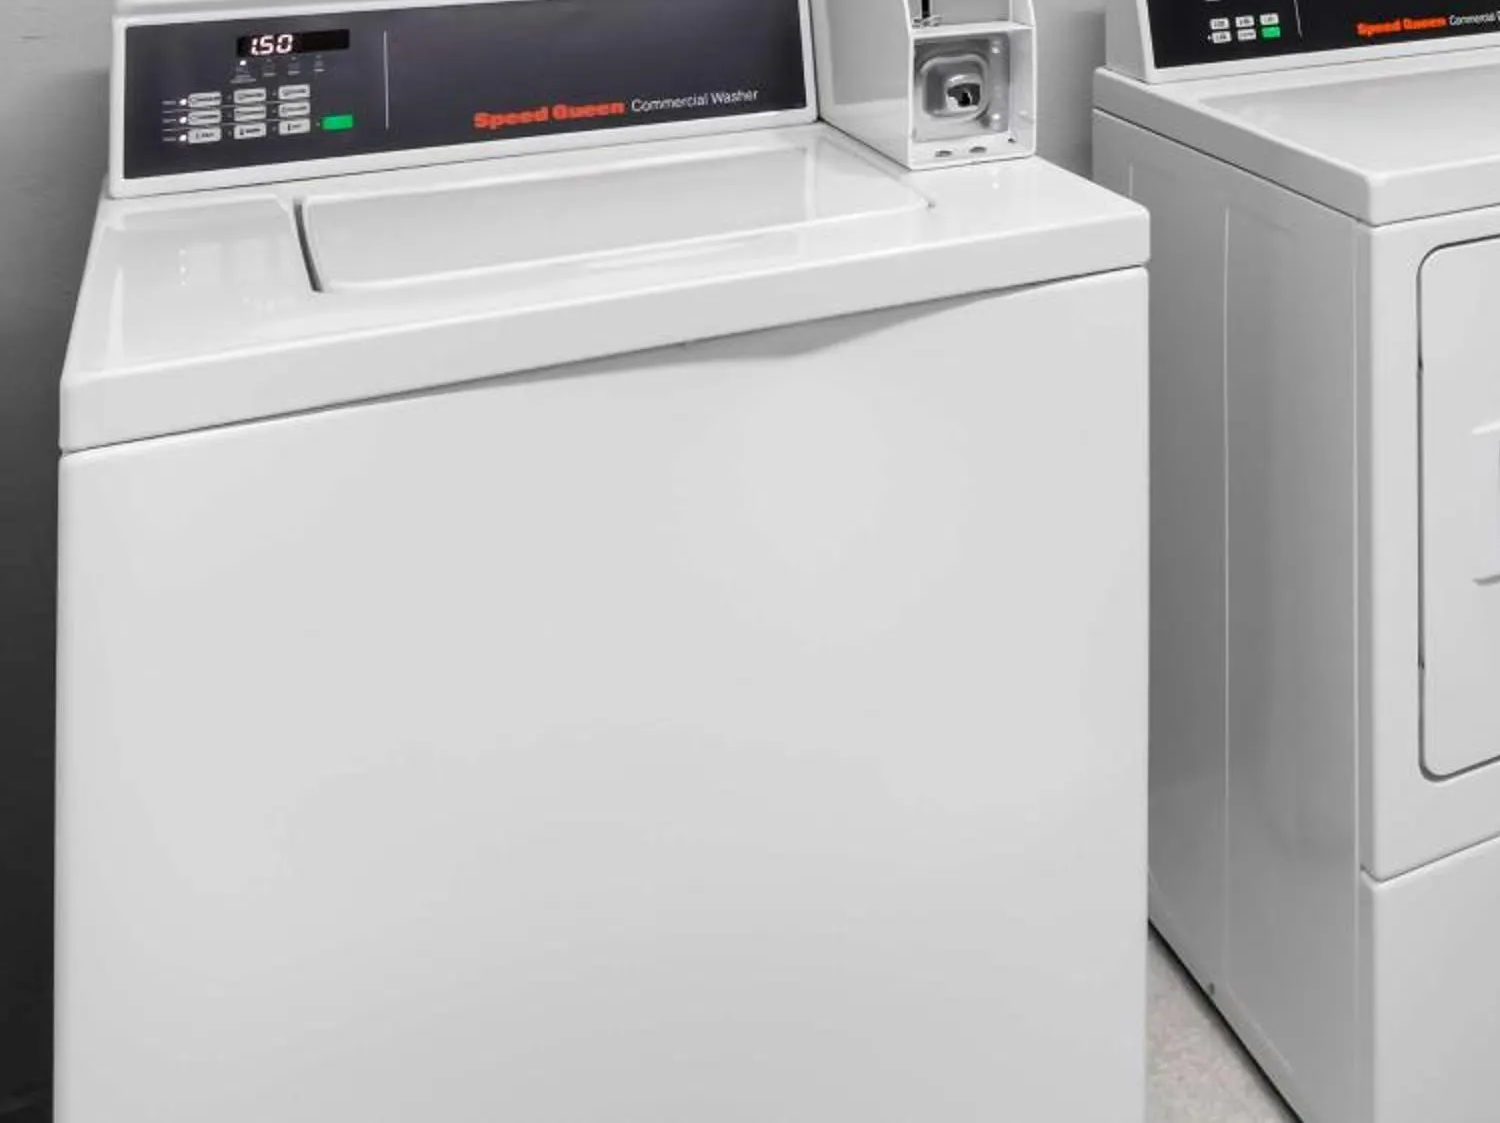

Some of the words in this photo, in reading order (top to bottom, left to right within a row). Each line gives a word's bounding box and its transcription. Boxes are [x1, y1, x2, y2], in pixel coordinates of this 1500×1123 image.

[473, 106, 549, 130] Speed
[551, 100, 625, 120] Queen
[631, 93, 709, 112] Commercial
[709, 89, 759, 106] Washer
